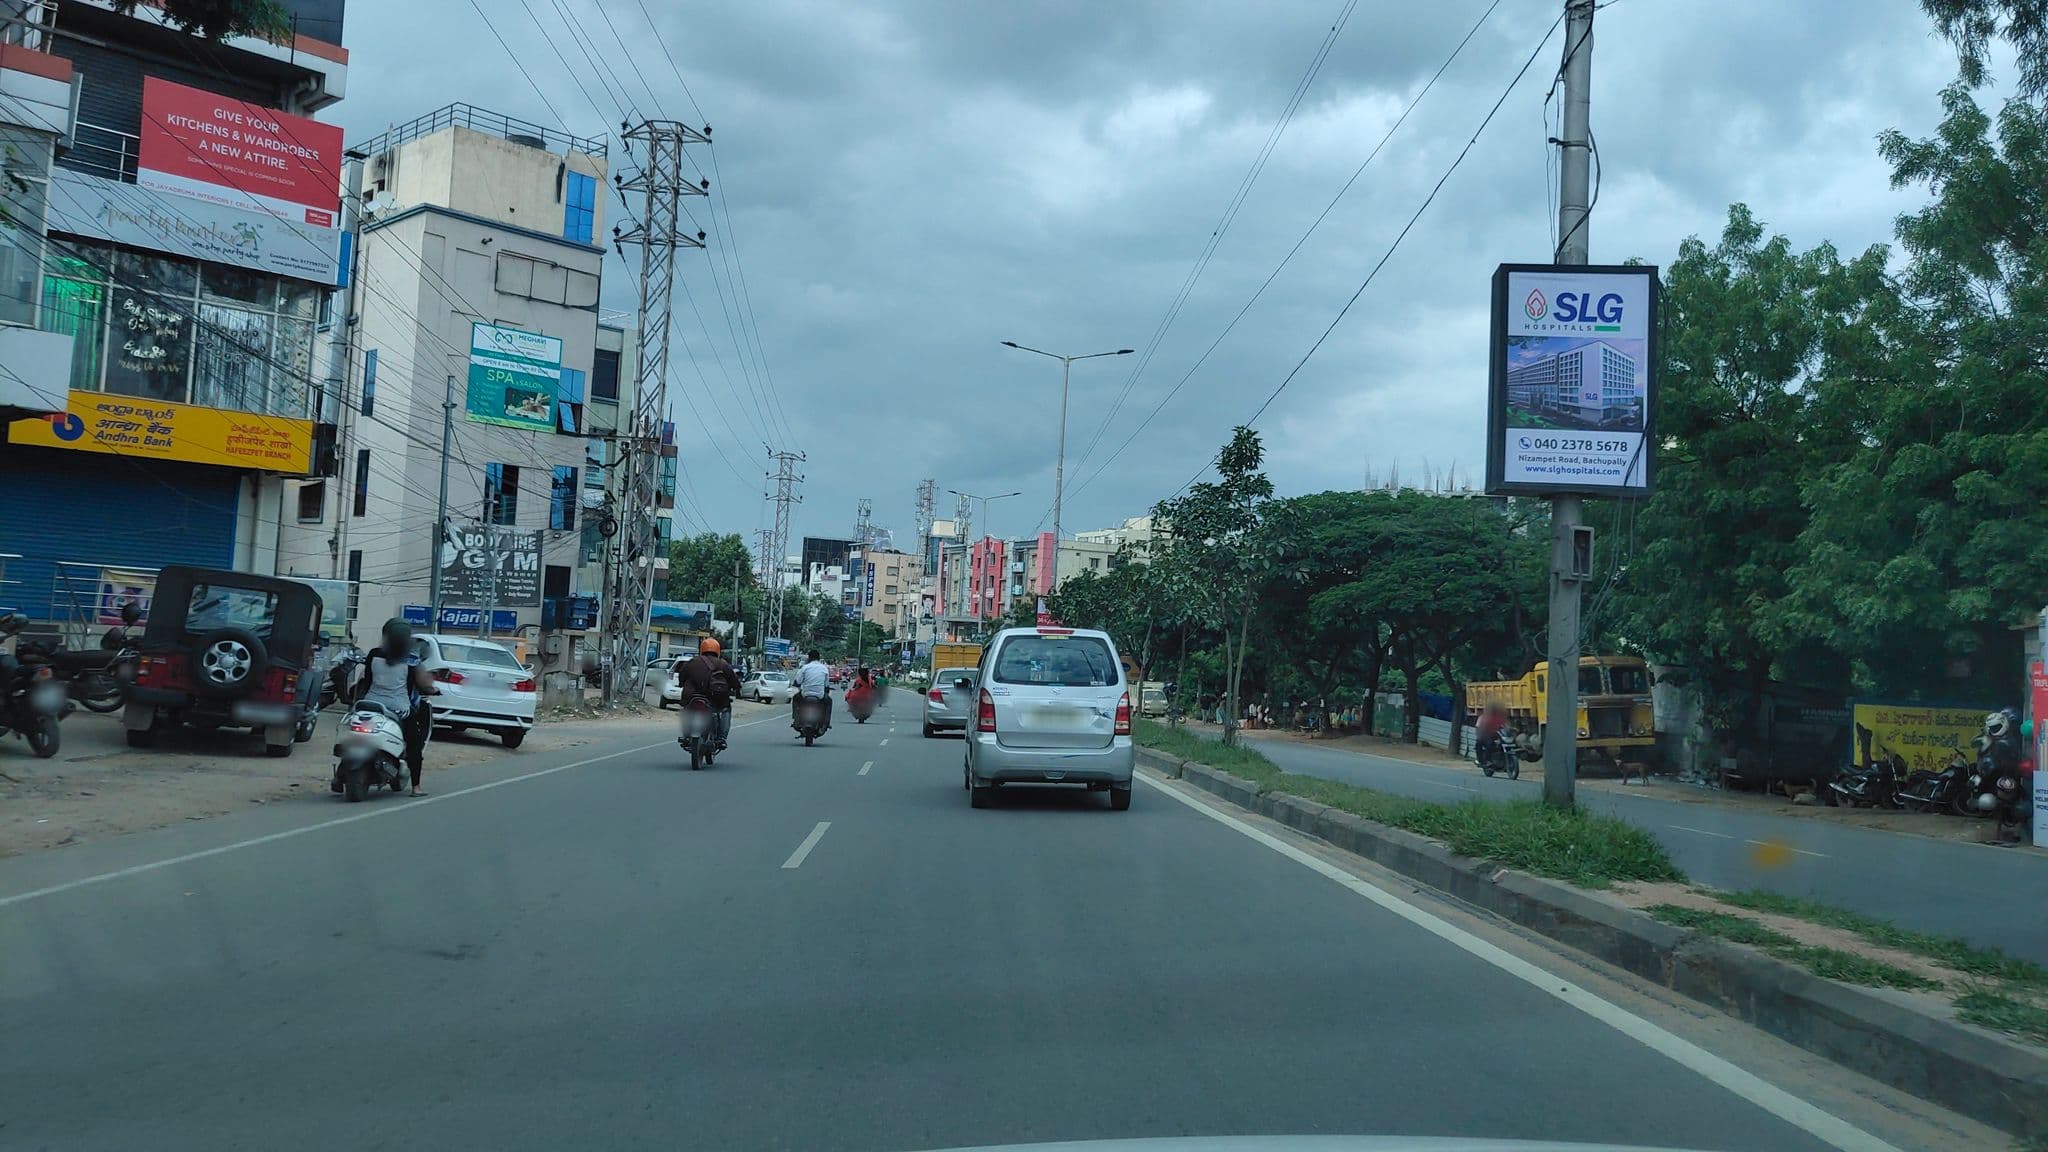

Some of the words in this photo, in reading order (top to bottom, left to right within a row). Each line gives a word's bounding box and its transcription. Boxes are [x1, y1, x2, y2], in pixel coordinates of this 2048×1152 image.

[214, 108, 242, 123] GIVE
[246, 116, 280, 134] YOUR
[167, 113, 229, 138] KITCHENS
[232, 130, 240, 140] &
[244, 133, 320, 161] WARDROBES
[199, 140, 208, 150] A
[212, 142, 241, 158] NEW
[244, 148, 289, 171] ATTIRE.
[1553, 292, 1624, 323] SLG
[1525, 324, 1592, 332] HOSPITALS
[487, 369, 514, 385] SPA
[95, 431, 139, 443] Andhra
[144, 435, 173, 447] Bank
[1534, 439, 1558, 449] 040
[1561, 439, 1593, 450] 2378
[1596, 441, 1628, 452] 5678
[1518, 455, 1556, 464] Nizampet
[1559, 456, 1581, 464] Road,
[1583, 457, 1627, 467] Bachupally
[1525, 465, 1620, 475] www.slghospitals.com
[463, 549, 538, 571] GYM
